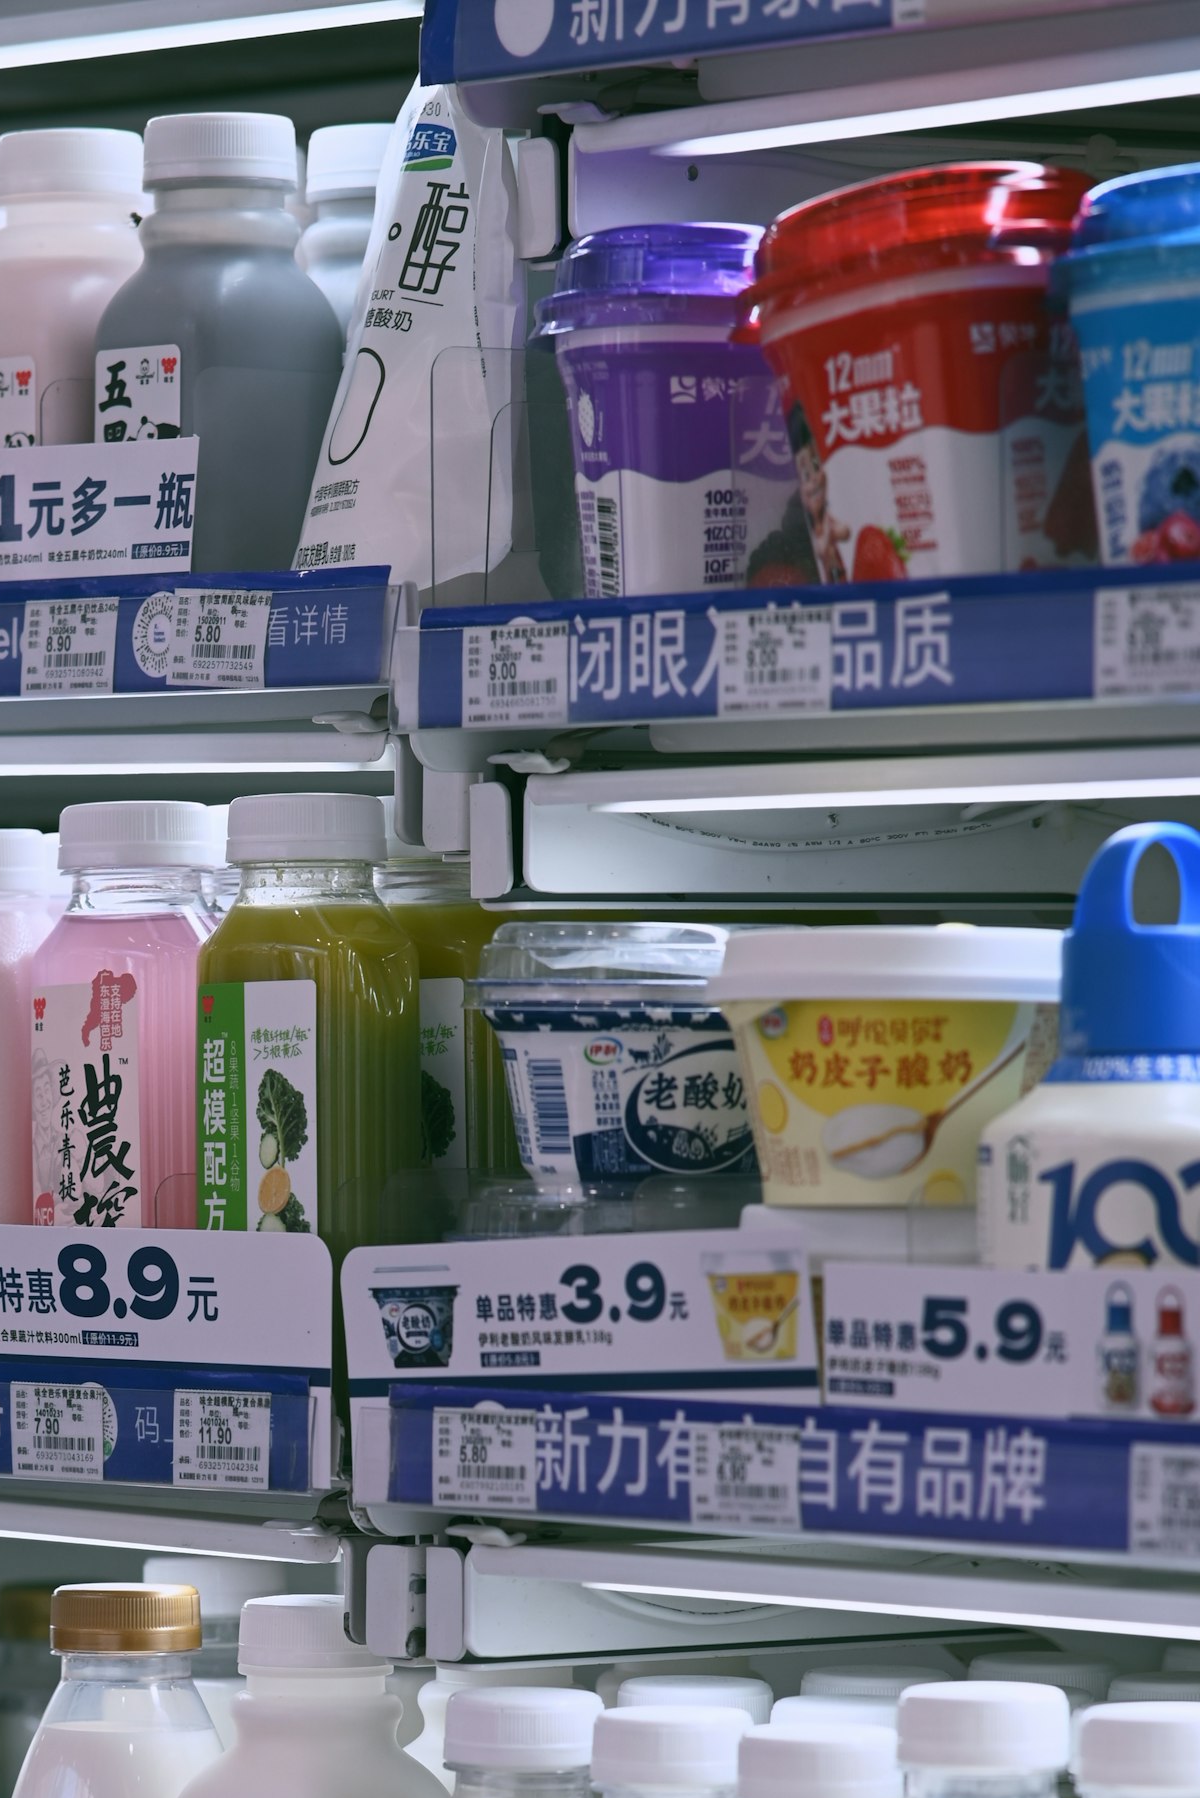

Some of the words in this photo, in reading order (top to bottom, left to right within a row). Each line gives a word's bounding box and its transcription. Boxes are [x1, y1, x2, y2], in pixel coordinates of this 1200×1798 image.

[824, 350, 894, 393] 12mm
[822, 383, 923, 446] 大果粒
[47, 548, 128, 563] 味全五黑牛奶饮240ml
[46, 636, 71, 652] 8.90
[195, 626, 221, 643] 5.80
[268, 603, 349, 647] 看详情
[193, 660, 253, 671] 6922577732549
[490, 663, 517, 680] 9.00
[100, 972, 112, 1050] 广东澄海芭乐
[110, 984, 122, 1037] 支持在地
[788, 1049, 973, 1091] 奶皮子酸奶
[58, 1064, 79, 1202] 芭乐青提
[203, 1039, 227, 1231] 超模配方
[475, 1261, 689, 1324] 单品特惠3.9元
[827, 1295, 1070, 1365] 单品特惠5.9元
[34, 1418, 60, 1435] 7.90
[199, 1427, 232, 1445] 11.90
[36, 1451, 94, 1463] 6932571043169
[459, 1445, 487, 1465] 5.80
[536, 1403, 1048, 1525] 新力有自有品牌
